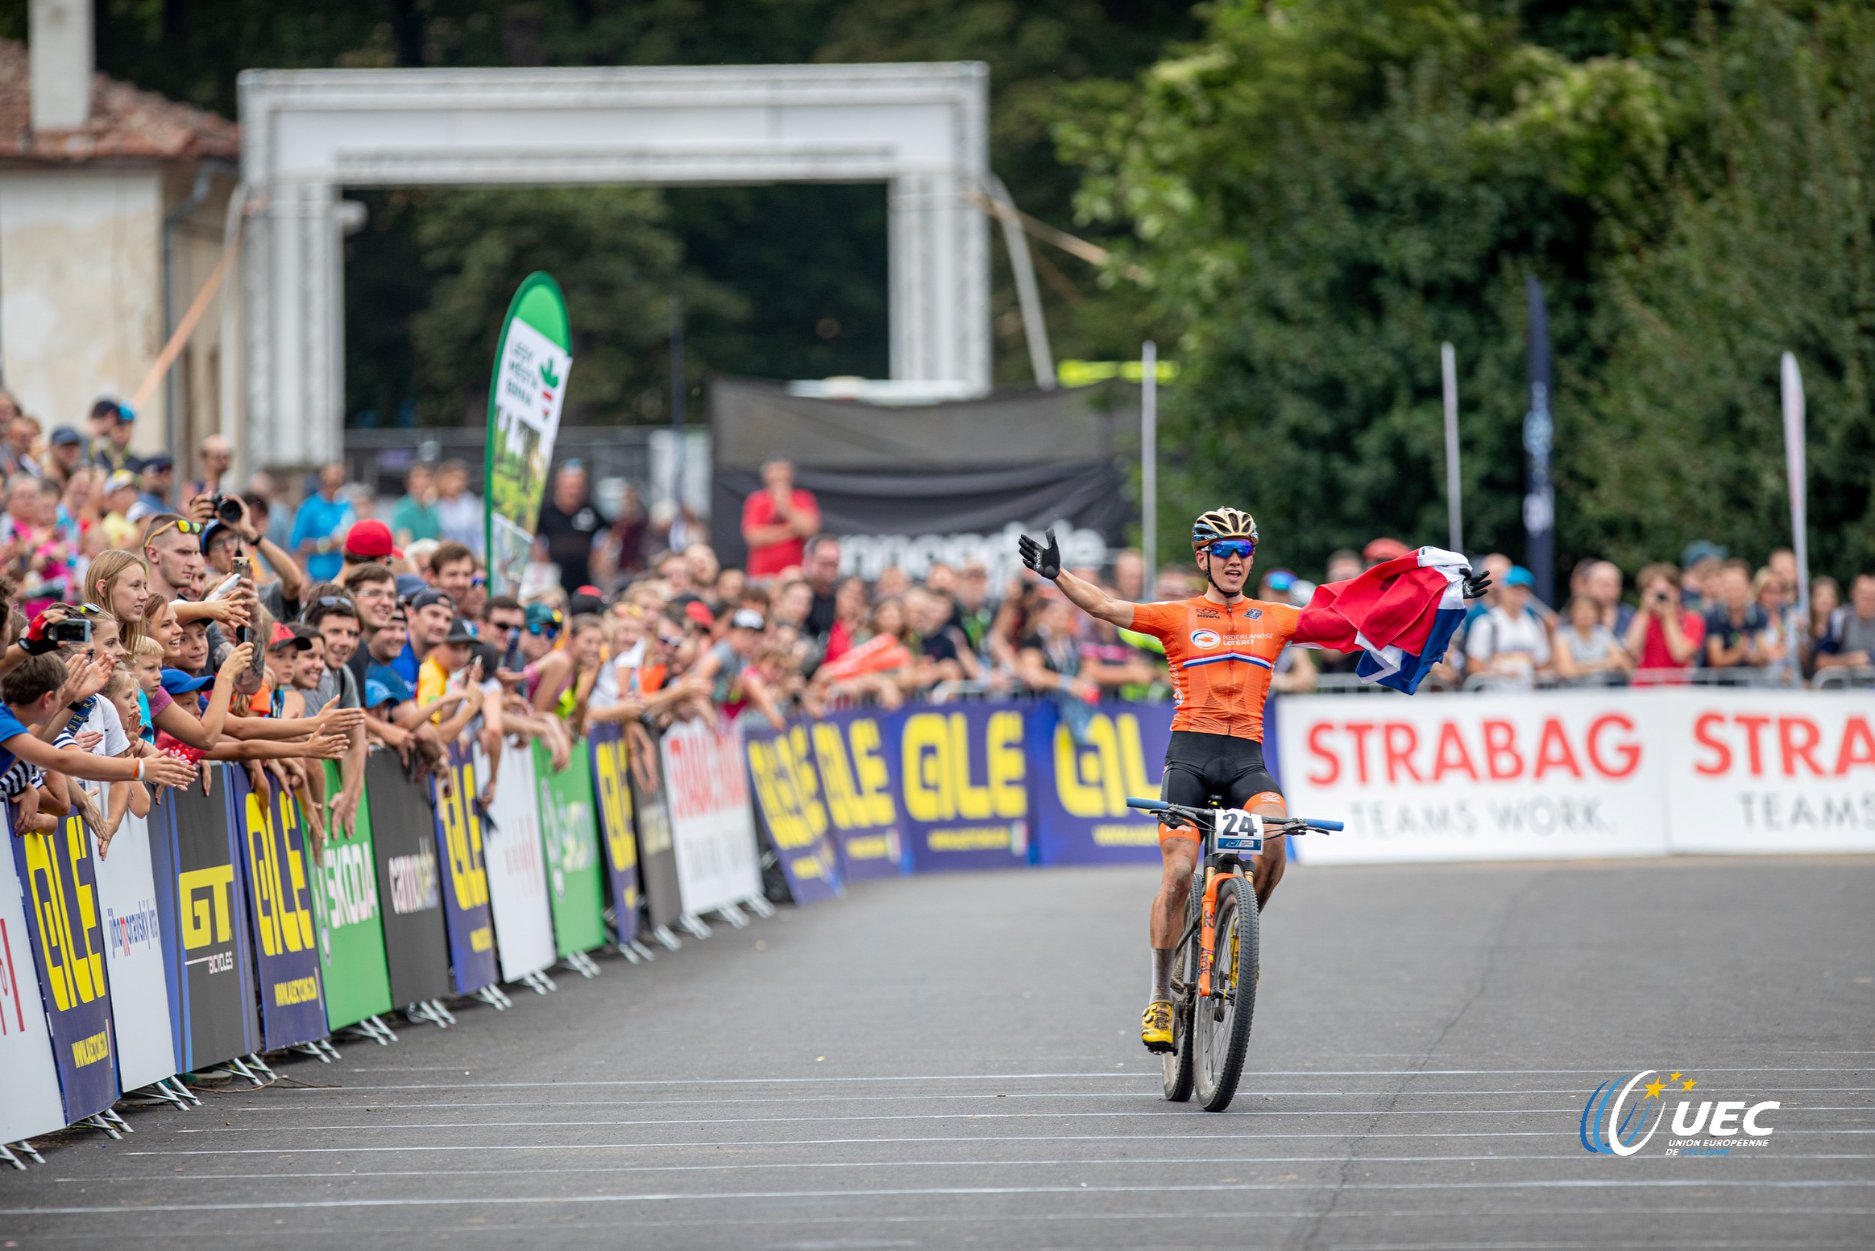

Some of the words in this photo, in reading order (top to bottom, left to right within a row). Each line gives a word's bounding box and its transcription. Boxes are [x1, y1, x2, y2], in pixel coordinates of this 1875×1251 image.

[1306, 712, 1644, 788] STRABAG
[1222, 813, 1258, 837] 24
[1348, 798, 1478, 840] TEAMS
[178, 864, 234, 950] GT
[208, 951, 233, 974] BICYCLES
